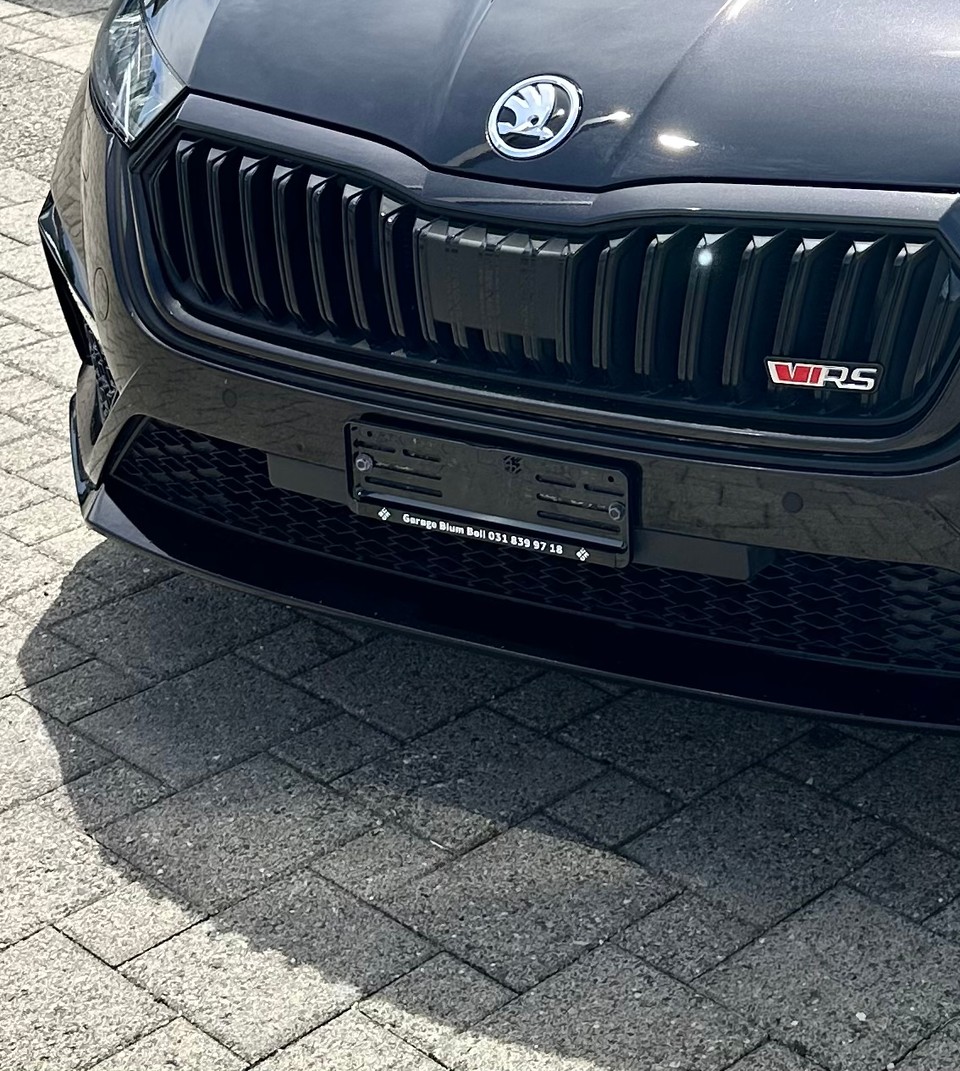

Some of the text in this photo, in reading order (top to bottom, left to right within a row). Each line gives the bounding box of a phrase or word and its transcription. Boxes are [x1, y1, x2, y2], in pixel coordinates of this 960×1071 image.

[439, 521, 465, 534] Blum
[488, 531, 508, 544] 031
[510, 536, 531, 548] 839
[533, 540, 547, 551] 97
[549, 543, 563, 555] 18
